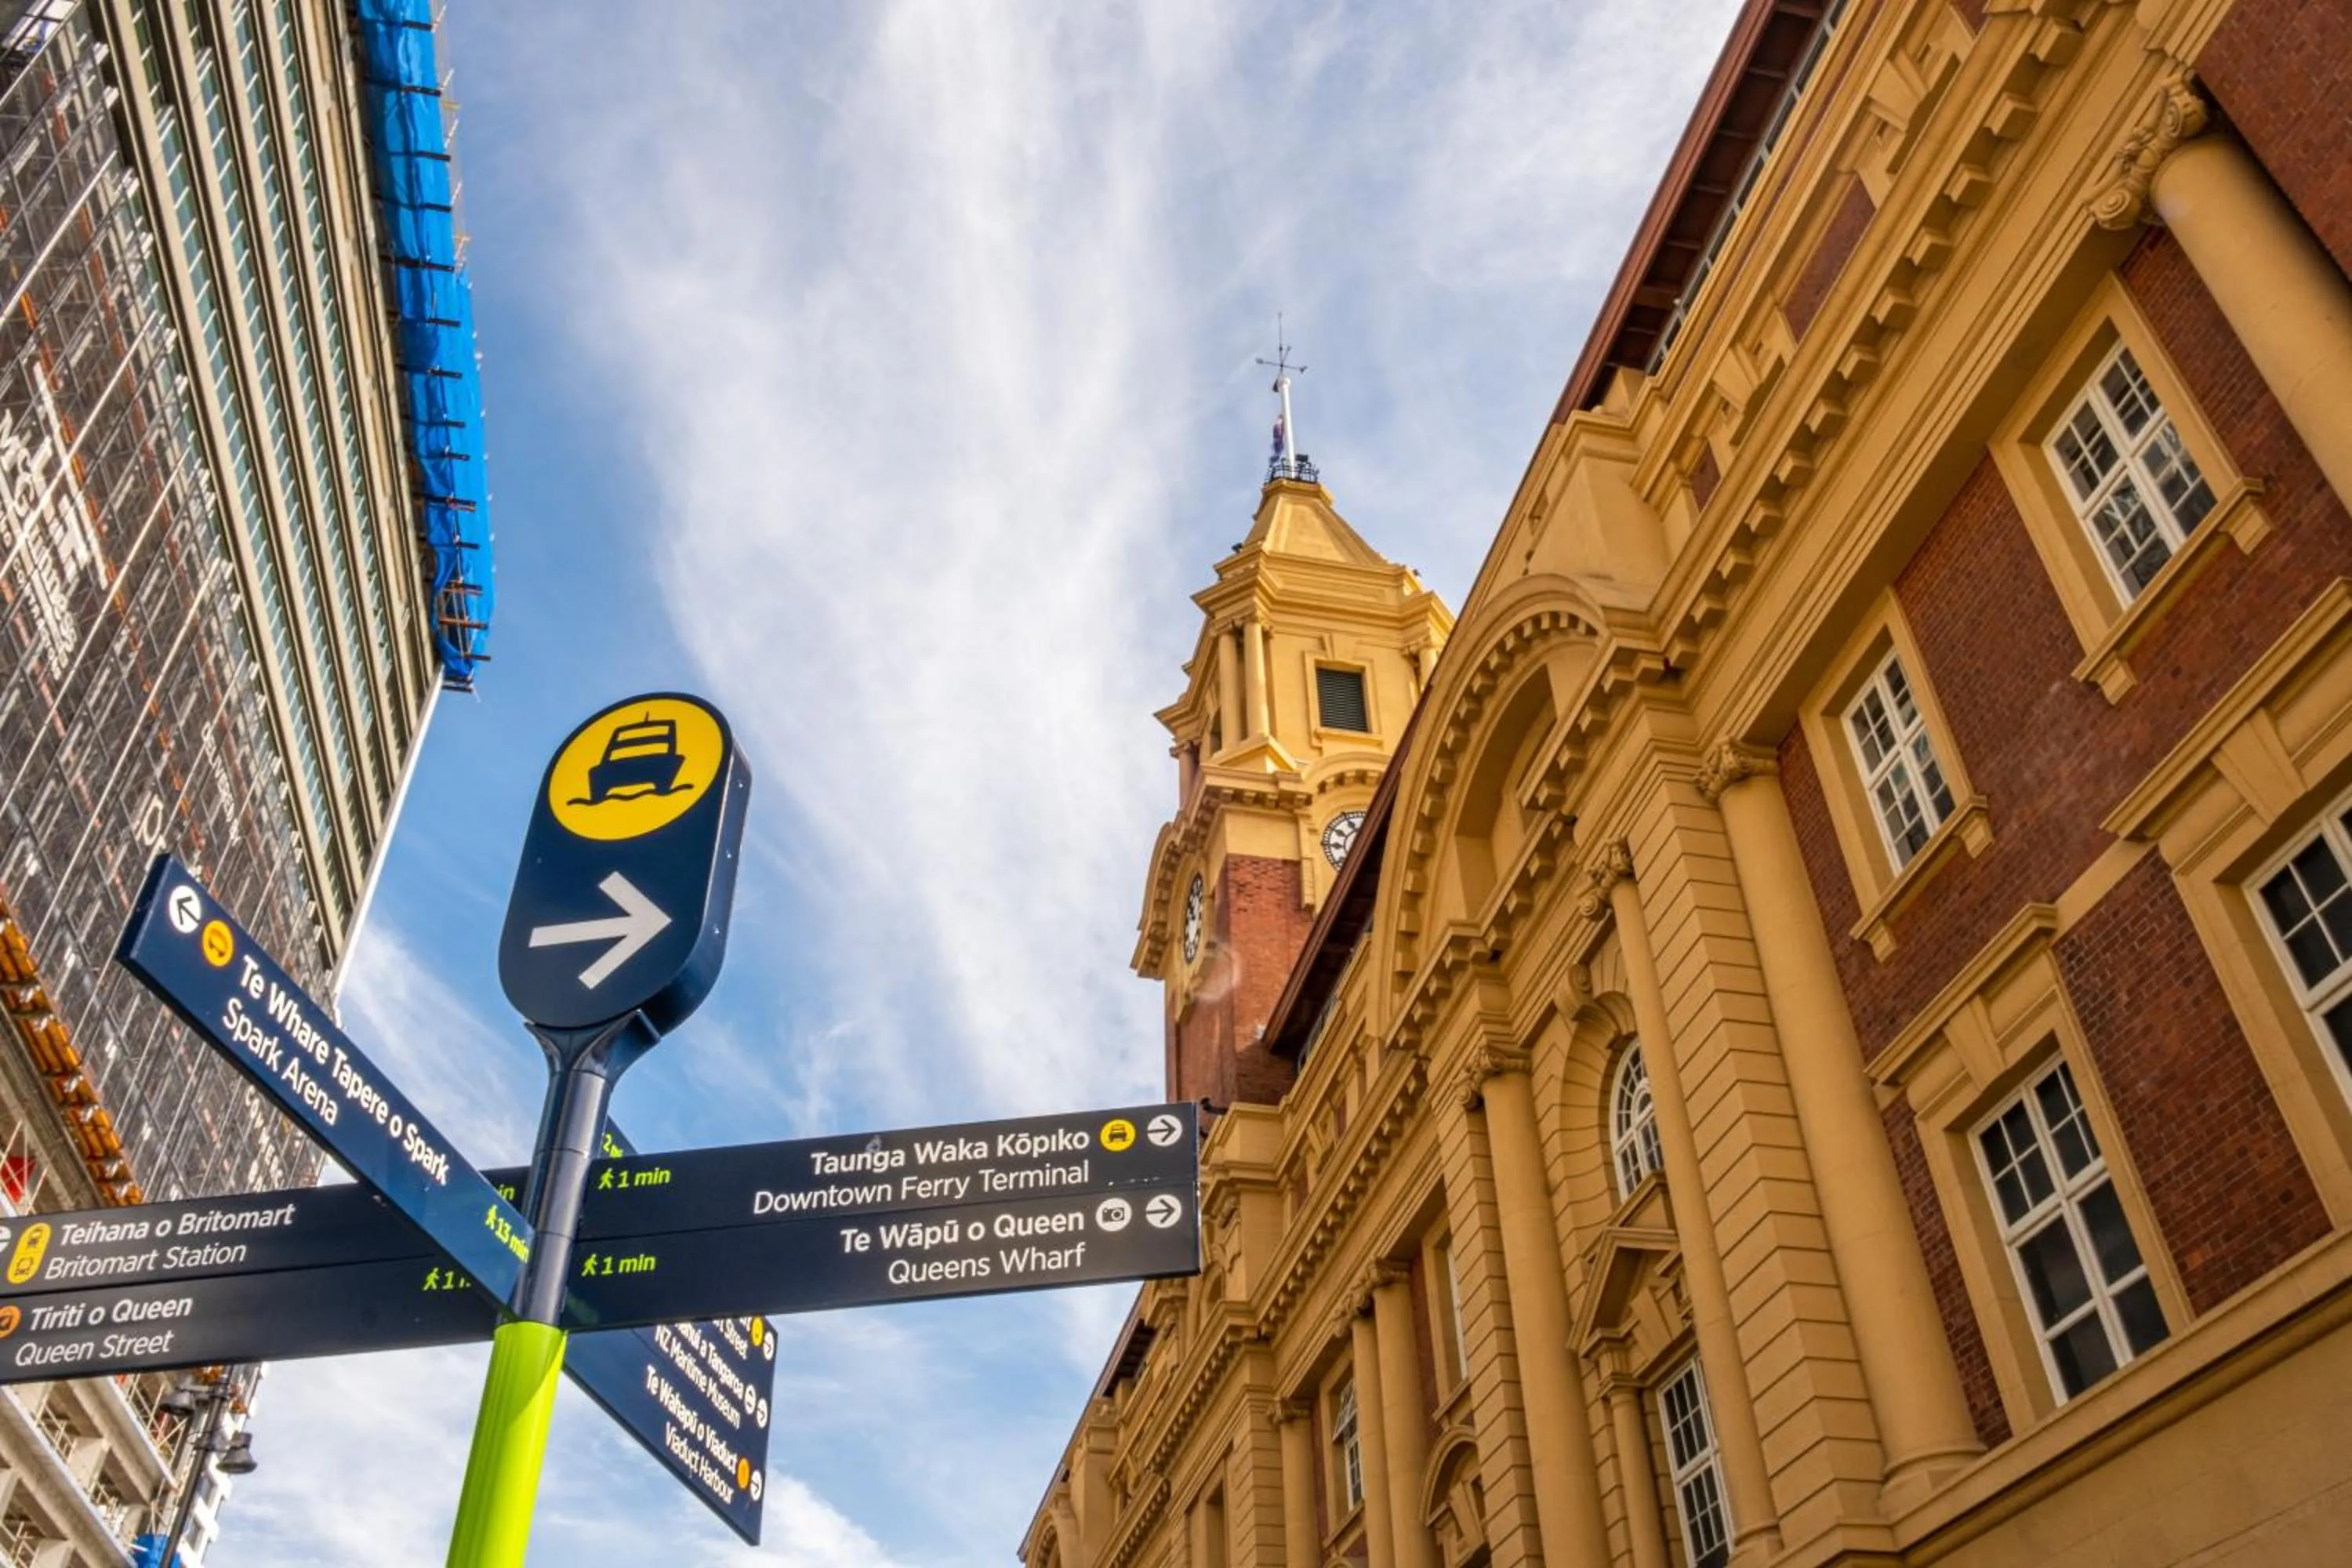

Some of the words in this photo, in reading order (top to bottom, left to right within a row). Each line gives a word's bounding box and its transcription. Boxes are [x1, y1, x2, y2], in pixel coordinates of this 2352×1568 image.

[222, 996, 283, 1073] Spark
[281, 1058, 339, 1127] Arena
[240, 954, 265, 1000] Te
[267, 982, 330, 1065] Whare
[332, 1050, 392, 1129] Tapere
[389, 1114, 403, 1138] o
[402, 1123, 450, 1186] Spark
[617, 1170, 629, 1189] 1
[633, 1167, 671, 1186] min
[810, 1145, 906, 1175] Taunga
[913, 1138, 989, 1165] Waka
[753, 1183, 893, 1214] Downtown
[901, 1175, 971, 1200] Ferry
[978, 1159, 1089, 1192] Terminal
[60, 1221, 150, 1247] Teihana
[154, 1219, 172, 1237] o
[176, 1203, 296, 1236] Britomart
[495, 1217, 513, 1244] 13
[510, 1234, 529, 1264] min
[840, 1229, 872, 1254] Te
[879, 1219, 960, 1250] Wāpū
[967, 1221, 985, 1241] o
[993, 1211, 1084, 1239] Queen
[44, 1249, 159, 1280] Britomart
[162, 1242, 247, 1269] Station
[441, 1270, 453, 1290] 1
[601, 1257, 613, 1276] 1
[617, 1252, 657, 1273] min
[887, 1257, 991, 1285] Queens
[999, 1241, 1086, 1274] Wharf
[31, 1302, 85, 1330] Tiriti
[87, 1305, 106, 1326] o
[111, 1298, 194, 1323] Queen
[15, 1341, 96, 1367] Queen
[99, 1330, 175, 1359] Street
[670, 1335, 708, 1393] Maritime
[706, 1376, 741, 1431] Museum
[646, 1363, 659, 1396] Te
[696, 1421, 706, 1442] o
[705, 1424, 739, 1475] Viaduct
[665, 1421, 700, 1475] Viaduct
[698, 1454, 735, 1505] Harbour
